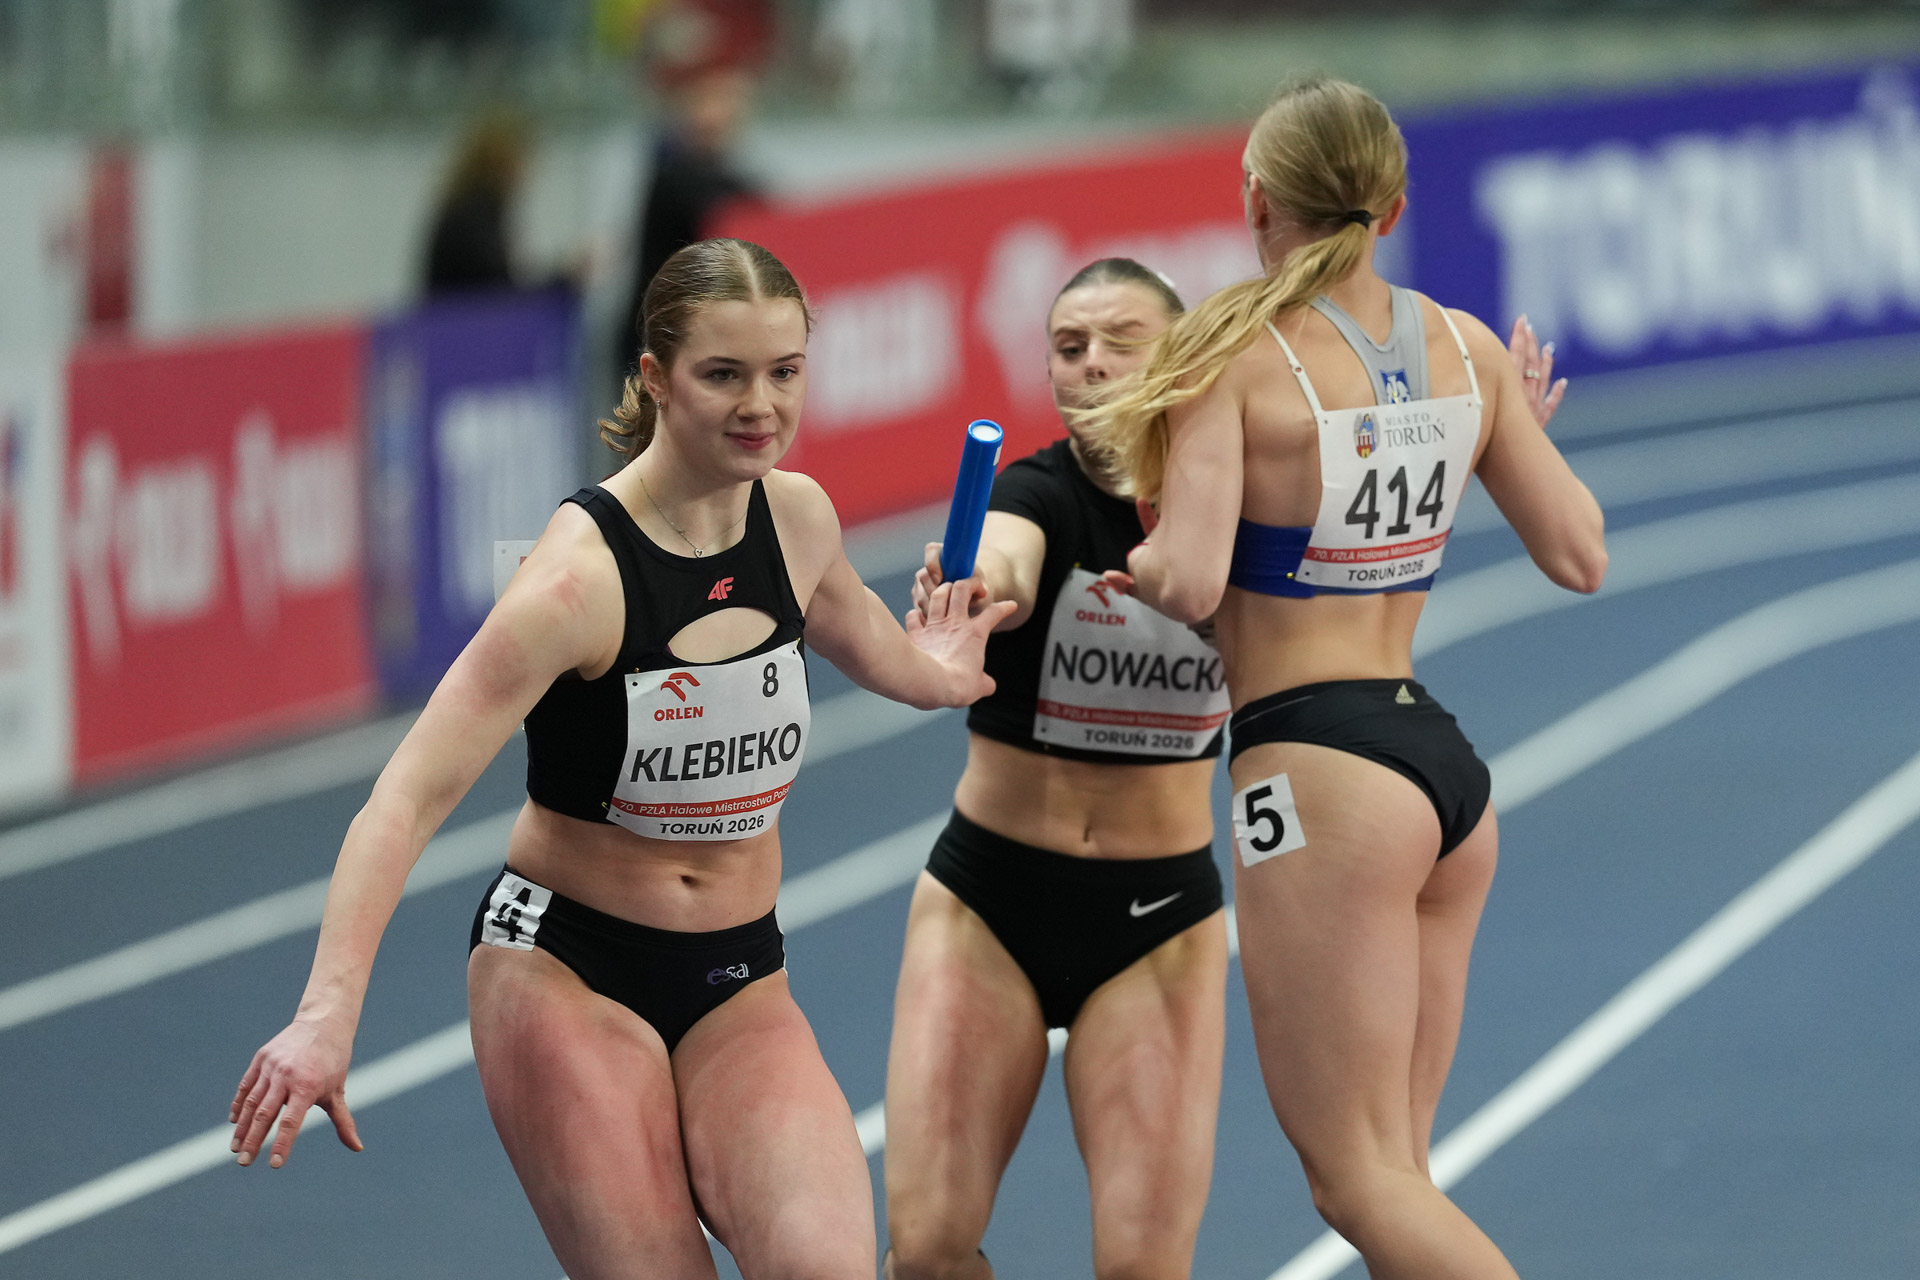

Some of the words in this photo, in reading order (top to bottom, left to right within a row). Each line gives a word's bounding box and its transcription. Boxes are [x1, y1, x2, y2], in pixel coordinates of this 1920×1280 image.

[1385, 412, 1430, 426] MIASTO
[1384, 417, 1445, 448] TORUŃ
[1345, 460, 1446, 539] 414
[1313, 550, 1328, 560] 70.
[1331, 551, 1355, 561] PZLA
[1348, 561, 1396, 581] TORUŃ
[1398, 560, 1424, 576] 2026
[708, 577, 734, 600] 4F
[1075, 609, 1126, 626] ORLEN
[762, 662, 779, 698] 8
[653, 706, 704, 721] ORLEN
[1084, 728, 1146, 747] TORUŃ
[1150, 733, 1194, 750] 2026
[630, 722, 802, 783] KLEBIEKO
[620, 801, 636, 812] 70.
[639, 805, 667, 815] PZLA
[669, 804, 713, 815] Halowe
[715, 795, 773, 813] Mistrzostwa
[659, 818, 724, 835] TORUŃ
[727, 815, 765, 833] 2026
[1246, 785, 1284, 852] 5
[492, 887, 532, 943] 4
